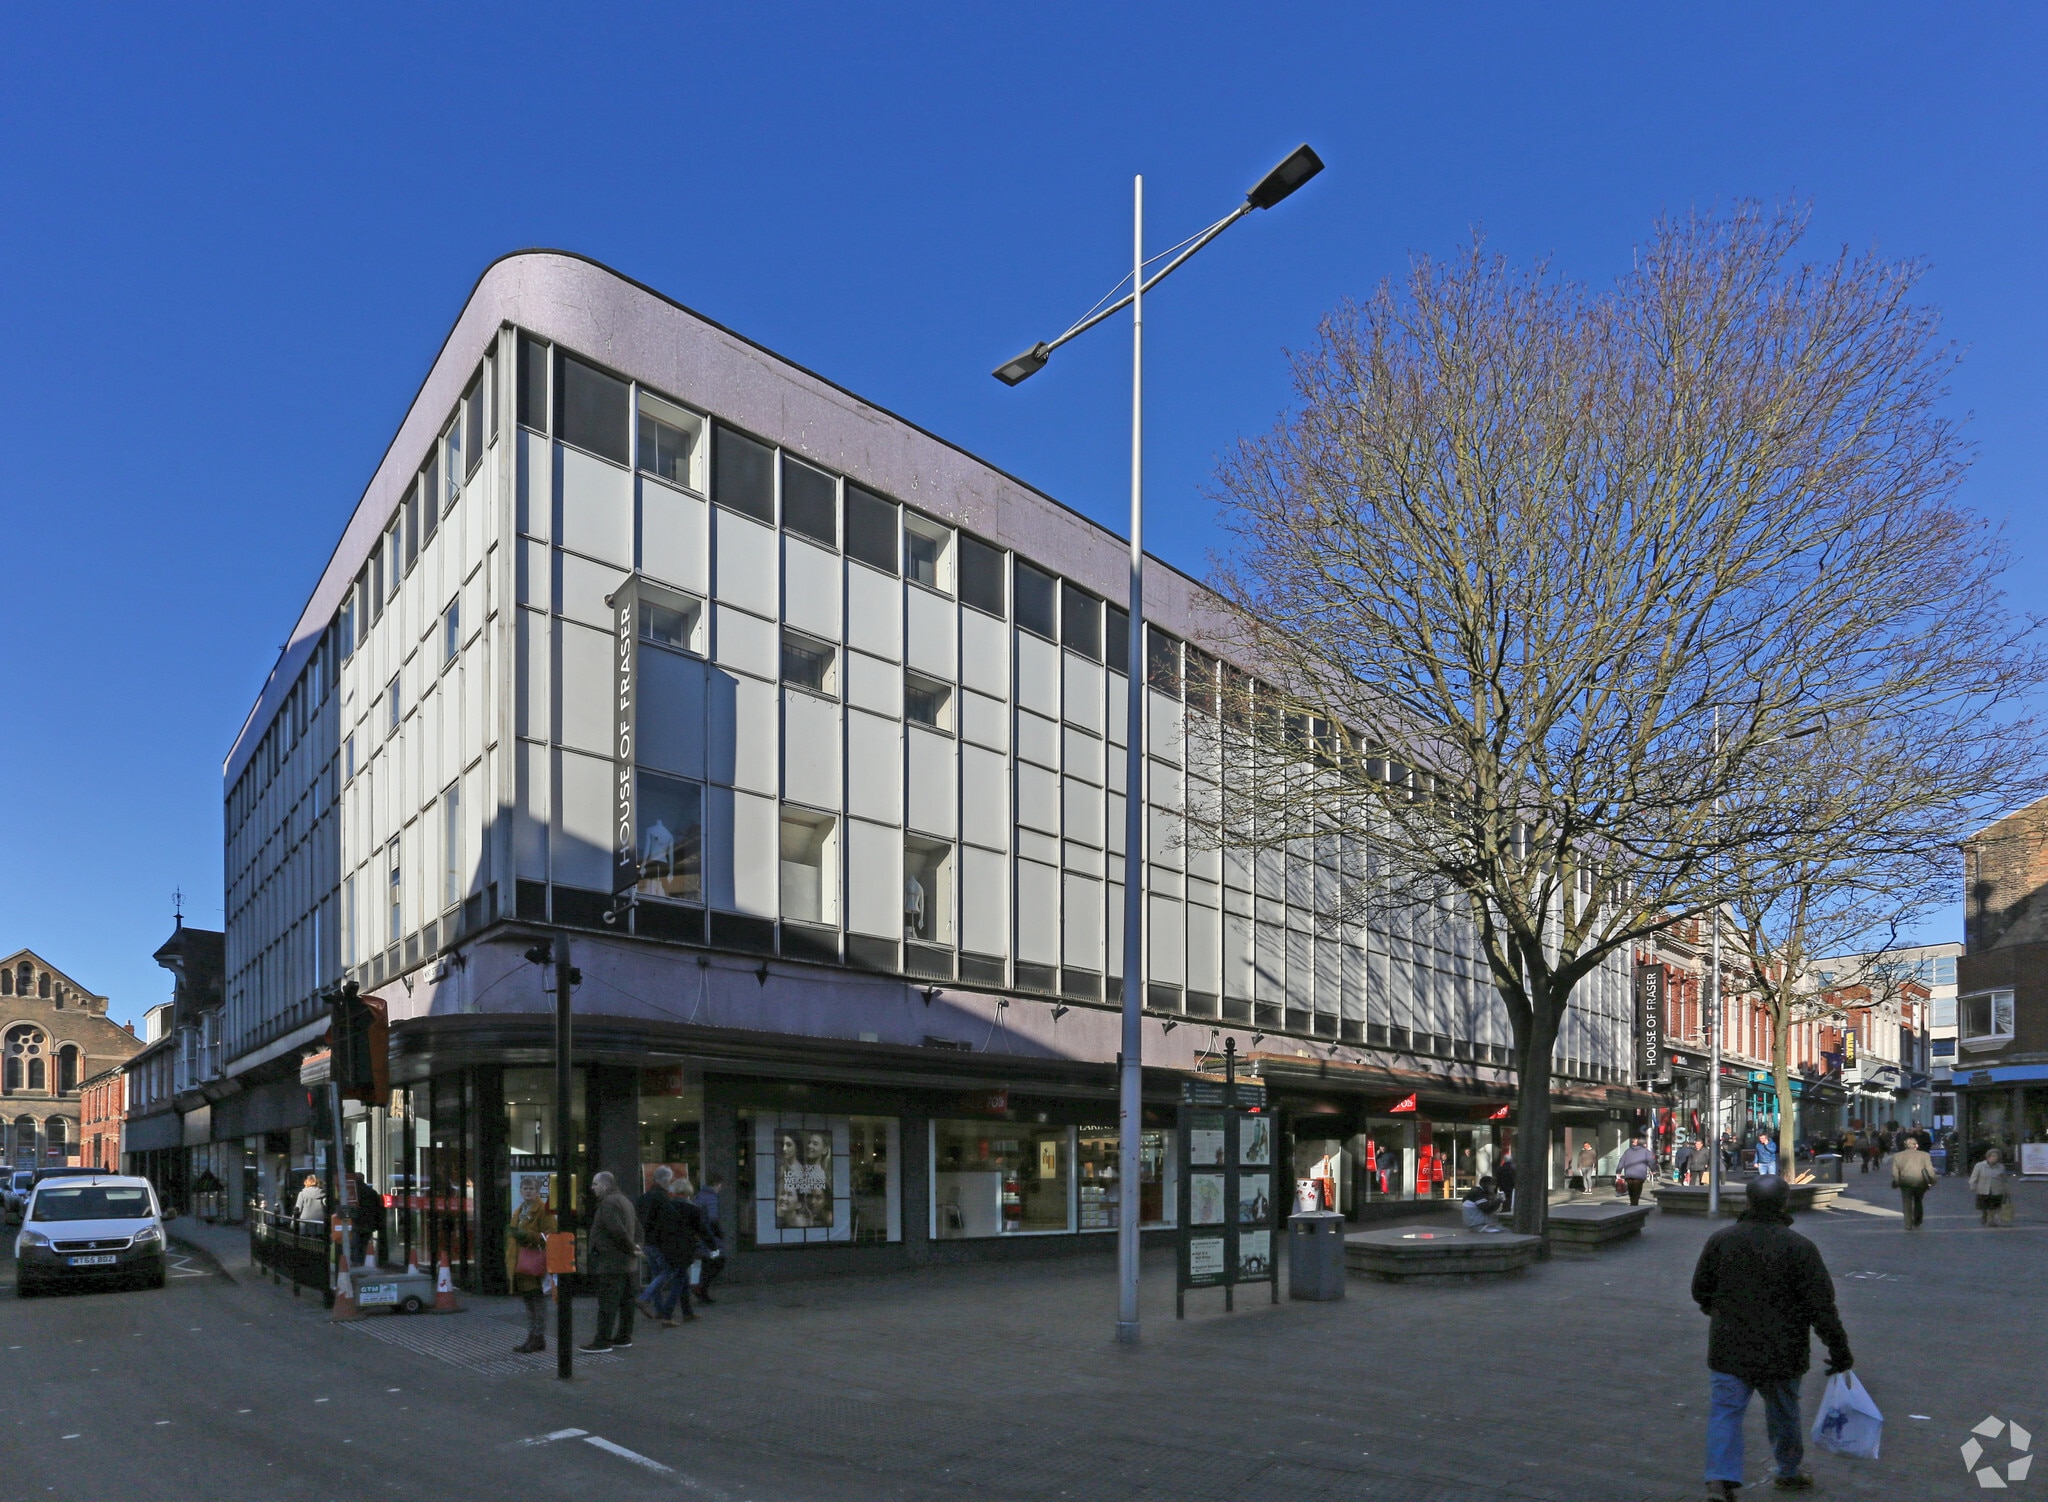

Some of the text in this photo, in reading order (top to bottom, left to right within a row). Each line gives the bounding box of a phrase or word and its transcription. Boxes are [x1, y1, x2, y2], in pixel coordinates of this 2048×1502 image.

[619, 602, 632, 867] HOUSE OF FRASER
[1646, 972, 1657, 1067] HOUSE OF FRASER
